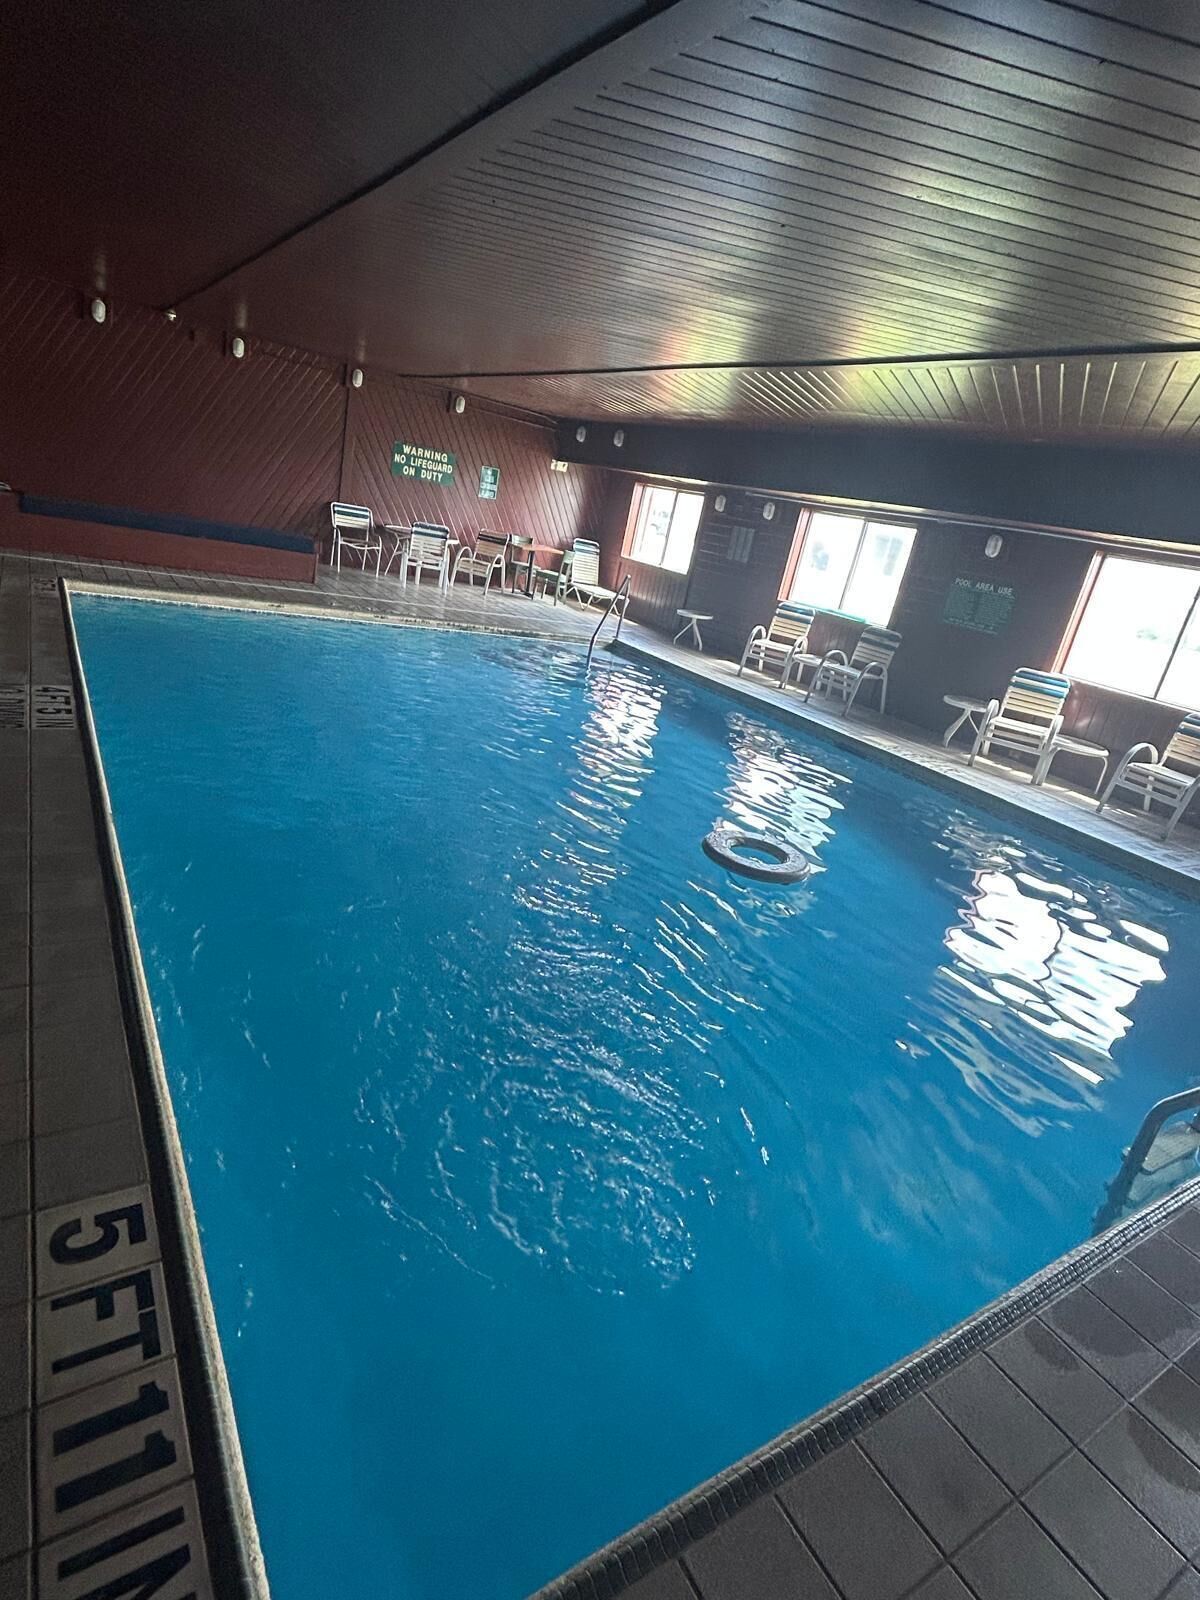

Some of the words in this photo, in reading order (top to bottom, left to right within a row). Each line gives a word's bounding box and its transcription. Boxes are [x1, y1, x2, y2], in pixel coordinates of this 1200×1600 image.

[403, 445, 448, 462] WARNING
[394, 453, 406, 464] NO
[410, 458, 453, 474] LIFEGUARD
[403, 466, 415, 476] ON
[421, 470, 443, 483] DUTY
[955, 577, 971, 587] POOL
[976, 582, 993, 591] AREA
[998, 586, 1013, 594] USE
[35, 694, 71, 706] FT
[36, 718, 74, 728] IN
[49, 1203, 148, 1266] 5
[50, 1269, 162, 1375] FT
[53, 1381, 177, 1514] 11
